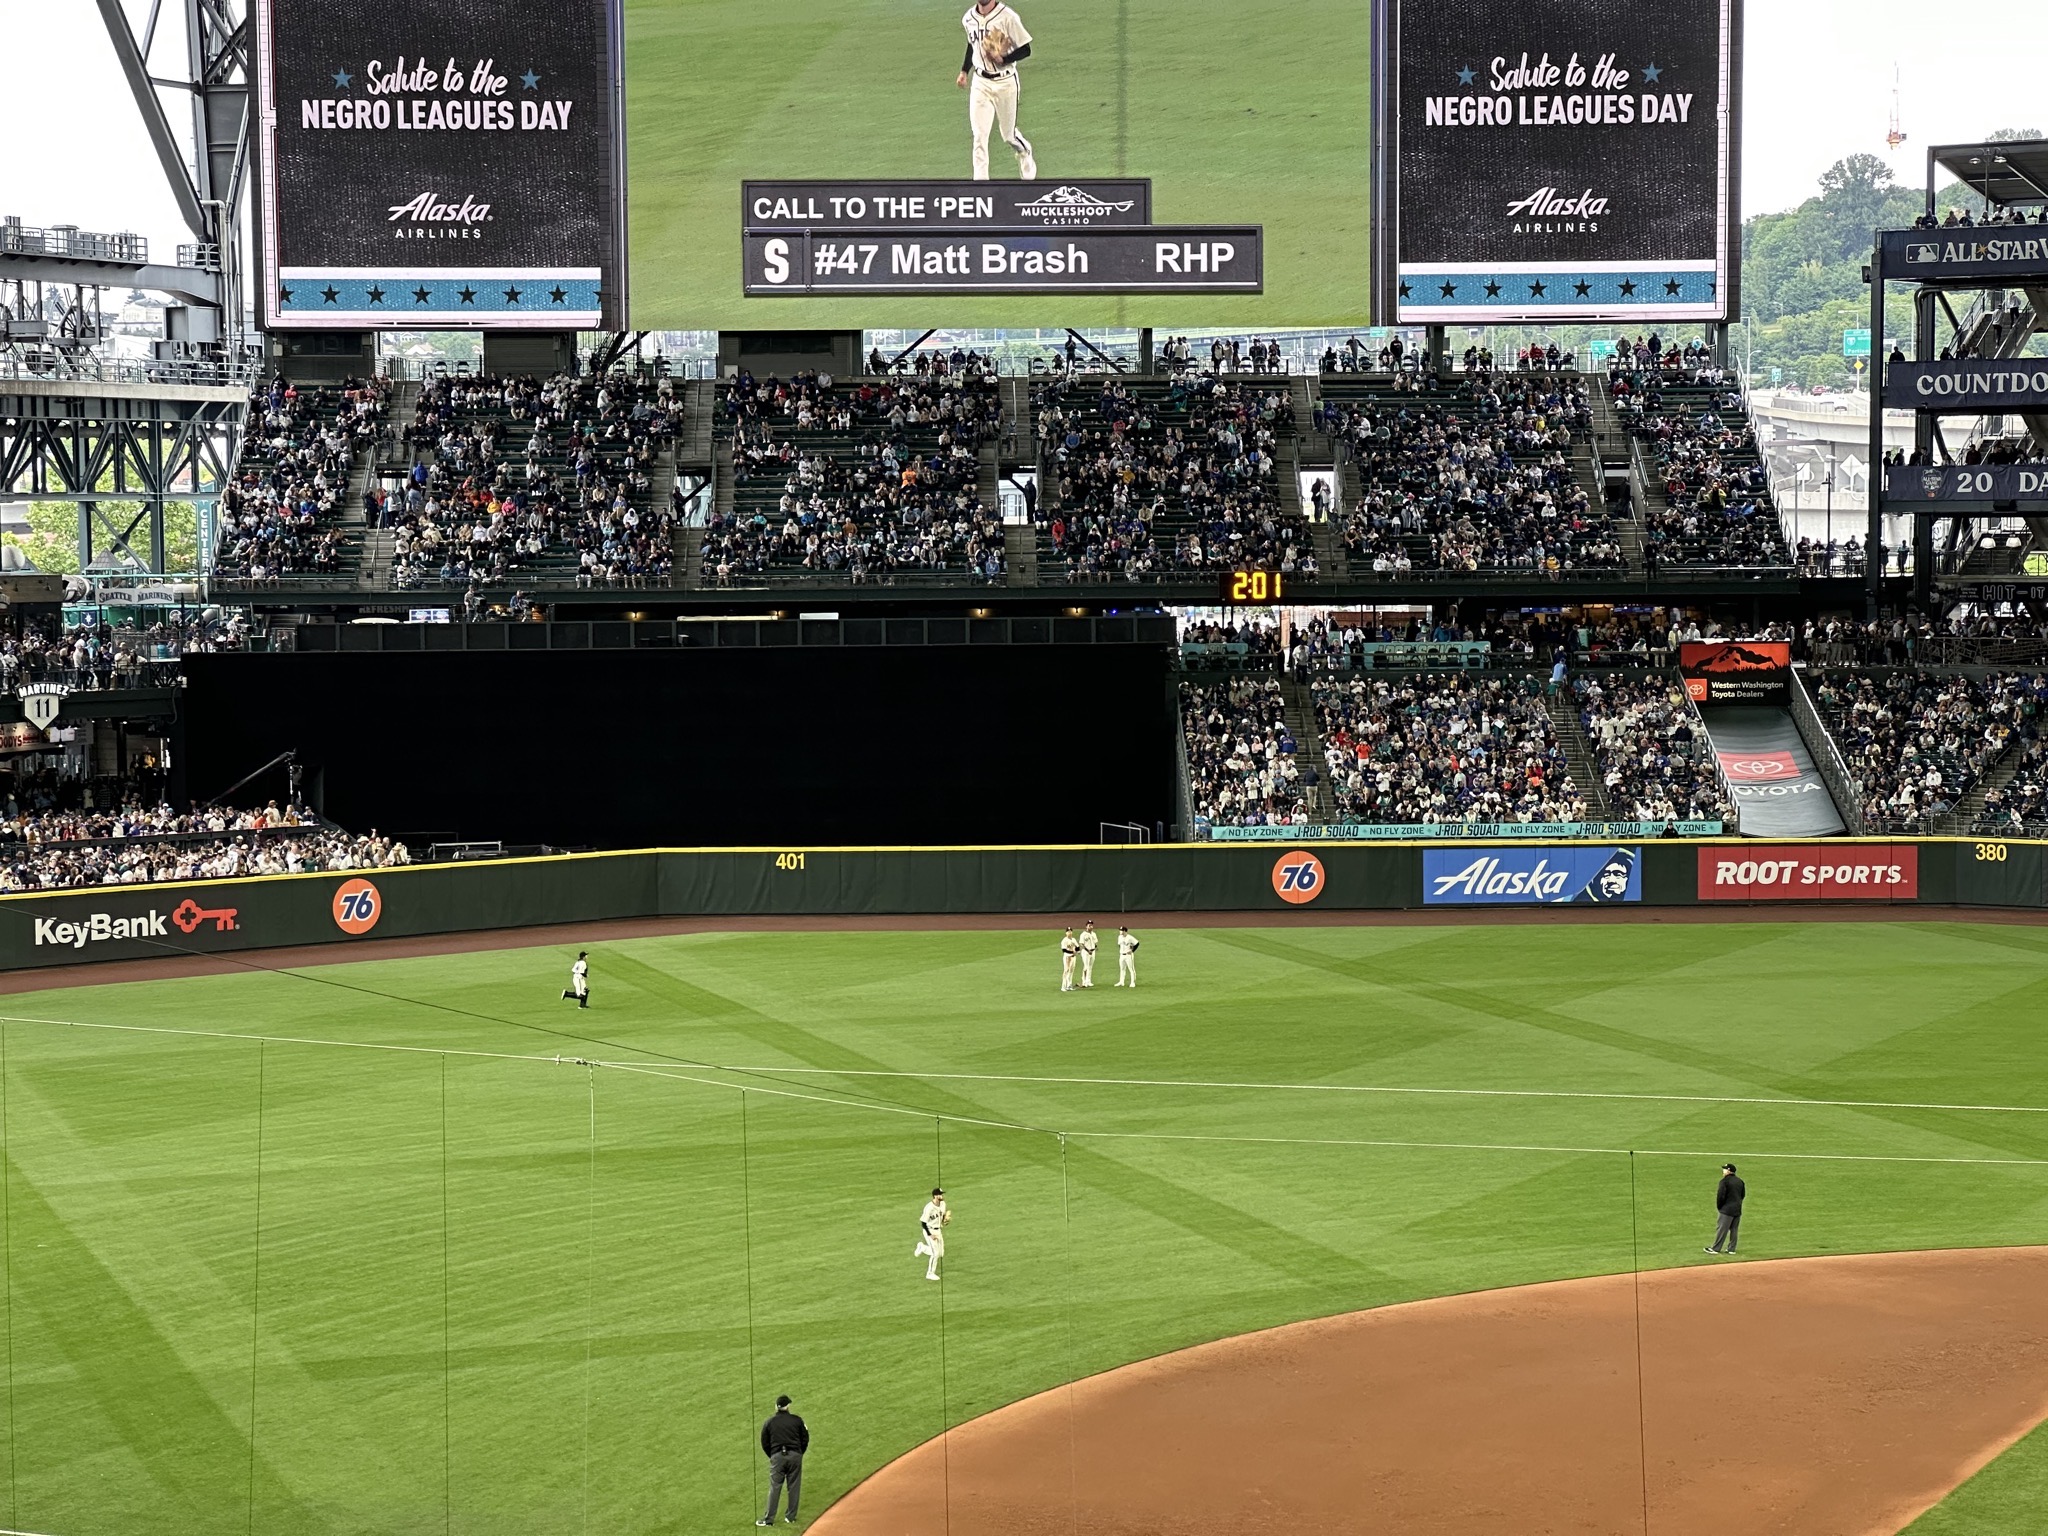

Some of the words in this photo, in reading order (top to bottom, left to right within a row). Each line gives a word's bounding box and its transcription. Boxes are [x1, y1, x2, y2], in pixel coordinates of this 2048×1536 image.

[366, 56, 438, 95] Salute
[442, 57, 464, 92] to
[469, 58, 508, 96] the
[1490, 52, 1560, 91] Salute
[1565, 52, 1586, 88] to
[1591, 52, 1630, 91] the
[301, 99, 390, 129] NEGRO
[397, 100, 514, 130] LEAGUES
[521, 101, 572, 130] DAY
[1426, 96, 1512, 126] NEGRO
[1519, 94, 1635, 125] LEAGUES
[1641, 93, 1693, 123] DAY
[388, 191, 490, 225] Alaska
[753, 197, 824, 219] CALL
[830, 197, 866, 219] TO
[873, 197, 926, 218] THE
[1021, 206, 1113, 217] MUCKLESHOOT
[1506, 186, 1608, 219] Alaska
[395, 228, 481, 239] AIRLINES
[1513, 222, 1598, 233] AIRLINES
[764, 238, 790, 284] S
[815, 244, 879, 275] #47
[891, 243, 970, 274] Matt
[982, 243, 1089, 274] Brash
[1155, 242, 1235, 273] RHP
[1916, 371, 2048, 395] COUNTDO
[1957, 472, 1993, 493] 20
[200, 509, 210, 567] CENTER
[99, 591, 133, 603] SEATTLE
[137, 591, 173, 602] MARINERS
[1233, 572, 1281, 599] 2:01
[18, 683, 70, 698] MARTINEZ
[1711, 681, 1740, 689] Western
[1741, 681, 1784, 690] Washington
[1711, 691, 1736, 699] Toyota
[1736, 690, 1764, 698] Dealers
[35, 698, 50, 718] 11
[1735, 783, 1821, 796] OYOTA
[1228, 828, 1242, 837] NO
[1243, 828, 1258, 837] FLY
[1260, 828, 1284, 836] ZONE
[1326, 825, 1359, 838] SQUAD
[1369, 827, 1383, 836] NO
[1384, 827, 1399, 836] FLY
[1401, 826, 1425, 835] ZONE
[1467, 824, 1500, 836] SQUAD
[1510, 825, 1524, 834] NO
[1525, 825, 1540, 834] FLY
[1541, 825, 1566, 834] ZONE
[1608, 823, 1641, 835] SQUAD
[1651, 824, 1664, 832] NO
[1683, 824, 1707, 832] ZONE
[775, 853, 805, 870] 401
[1975, 843, 2007, 862] 380
[1279, 861, 1318, 892] 76
[1433, 857, 1569, 900] Alaska
[1716, 861, 1799, 885] ROOT
[1800, 865, 1902, 884] SPORTS
[340, 889, 375, 922] 76
[35, 910, 168, 948] KeyBank
